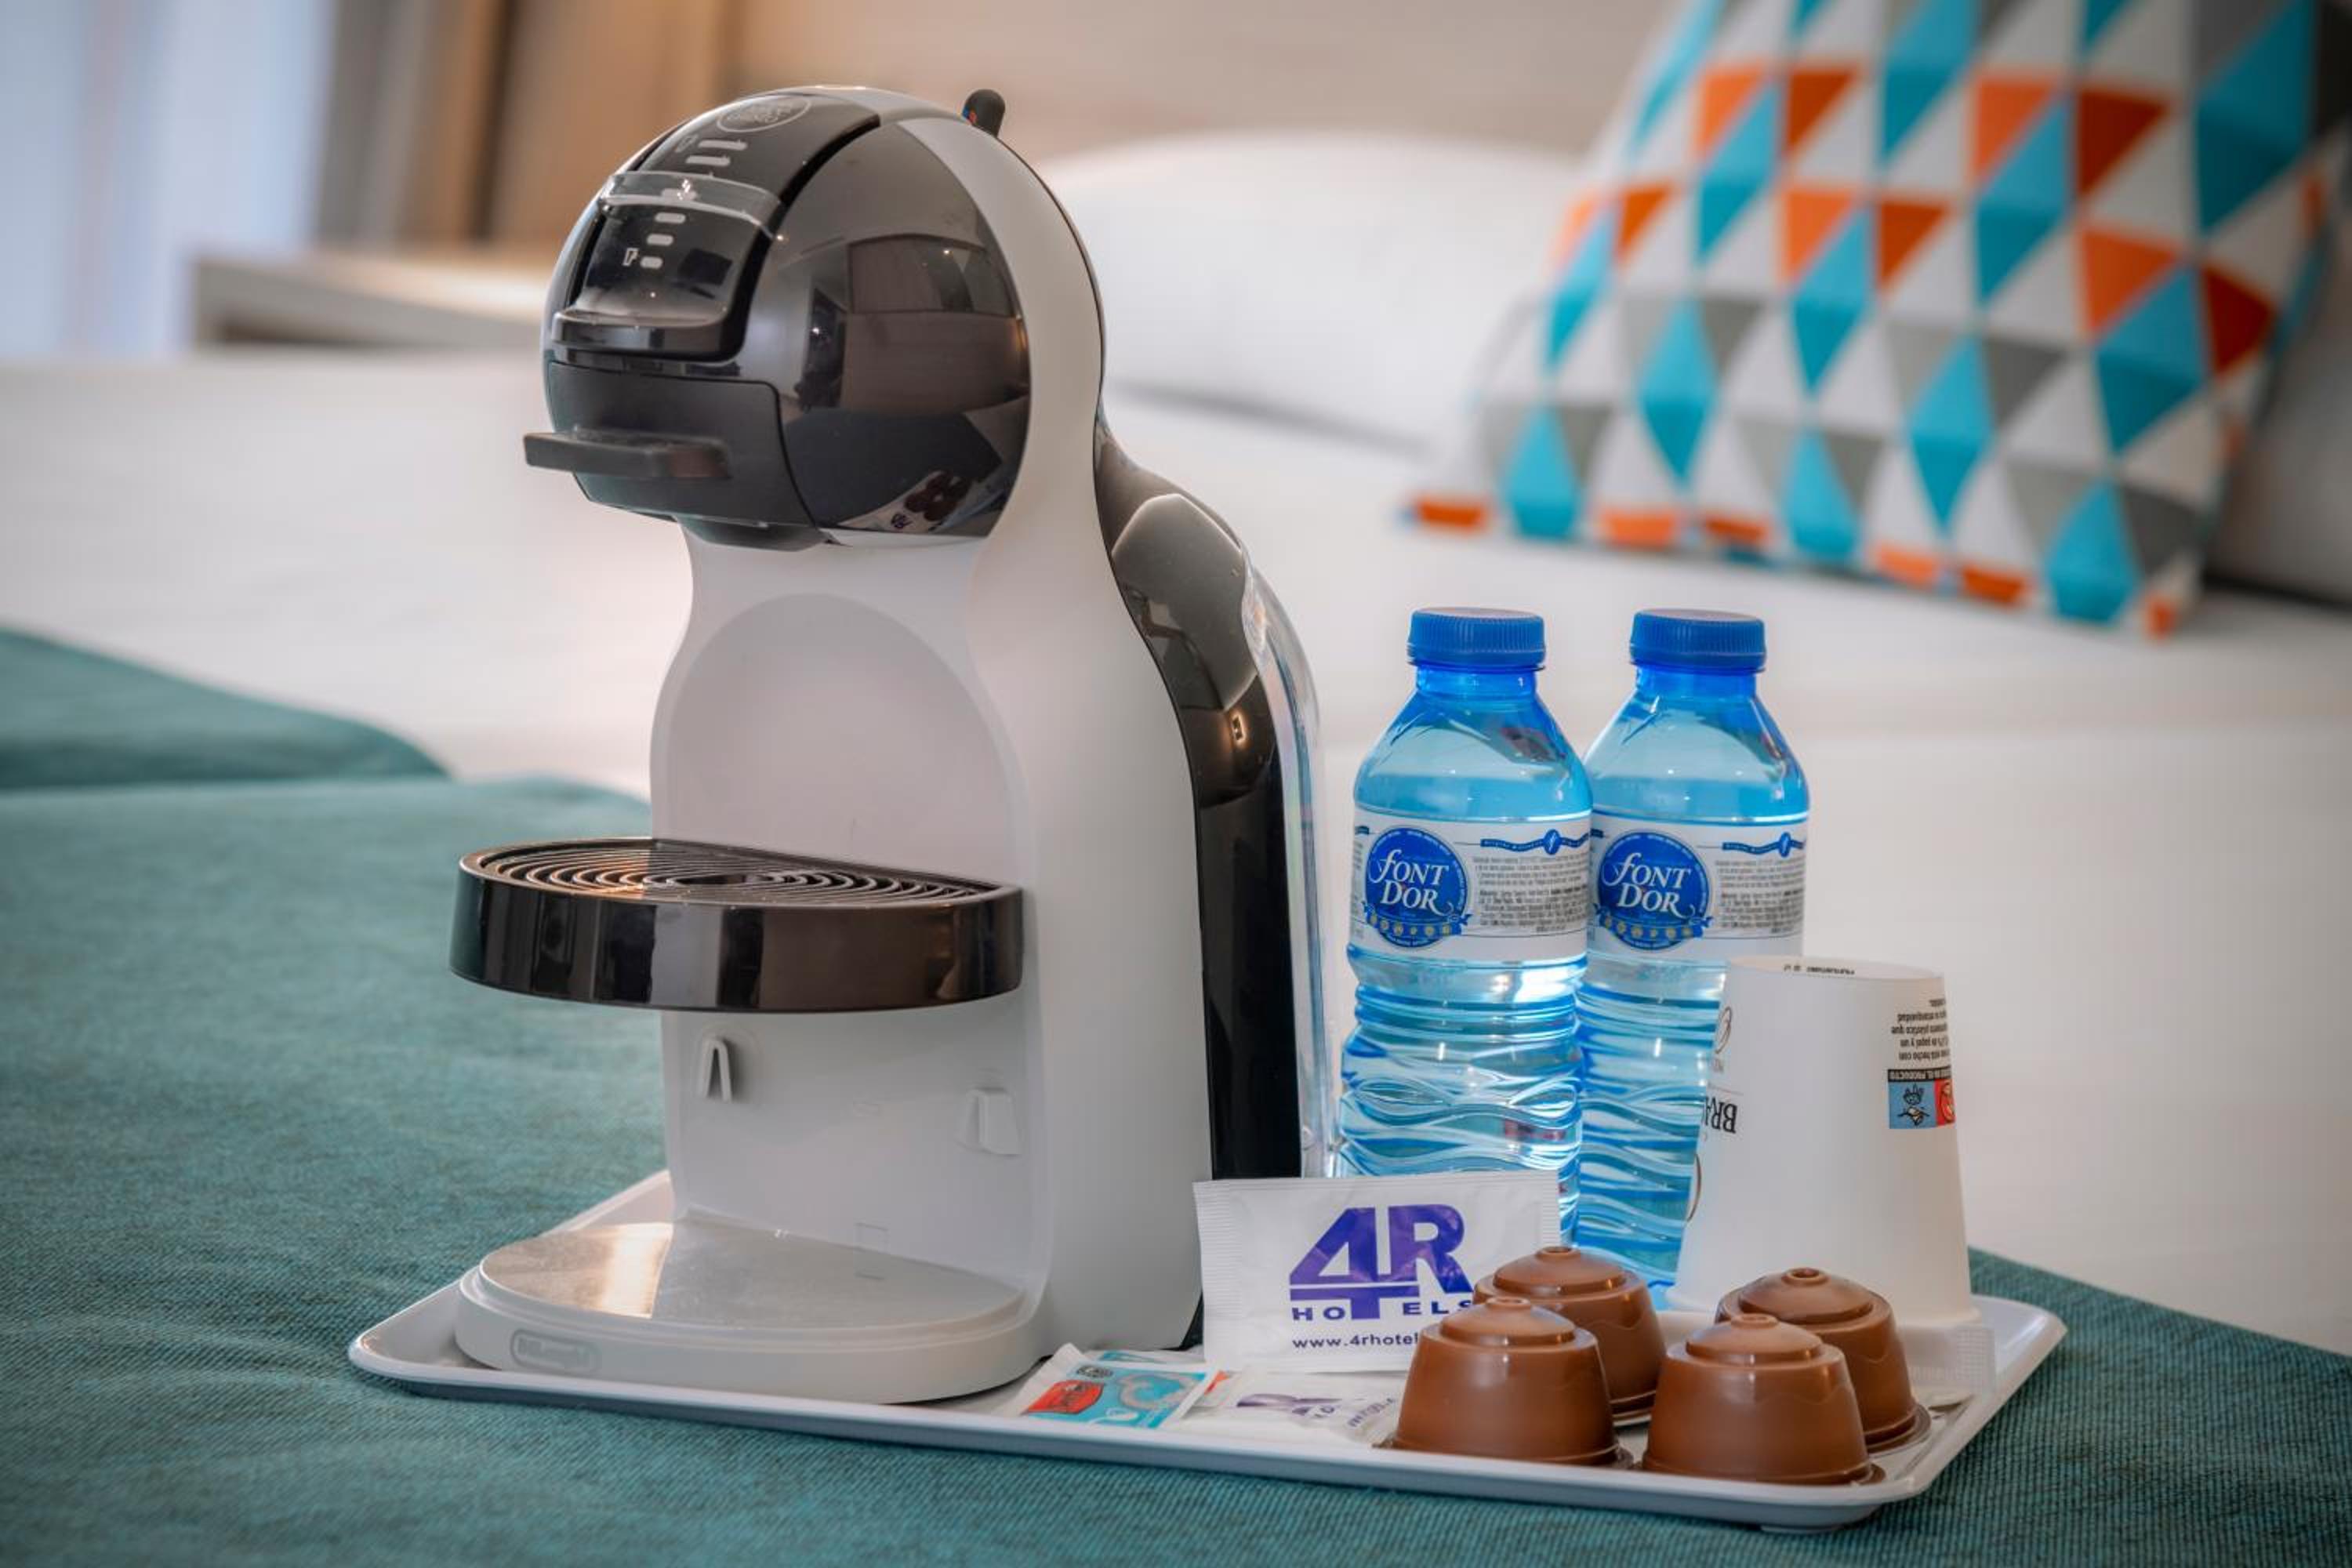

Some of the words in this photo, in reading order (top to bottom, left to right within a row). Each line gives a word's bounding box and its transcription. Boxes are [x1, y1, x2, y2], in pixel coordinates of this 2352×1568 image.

[1702, 1096, 1738, 1134] BRA
[1290, 1204, 1473, 1303] 4R
[1292, 1333, 1418, 1348] www.4rhotel
